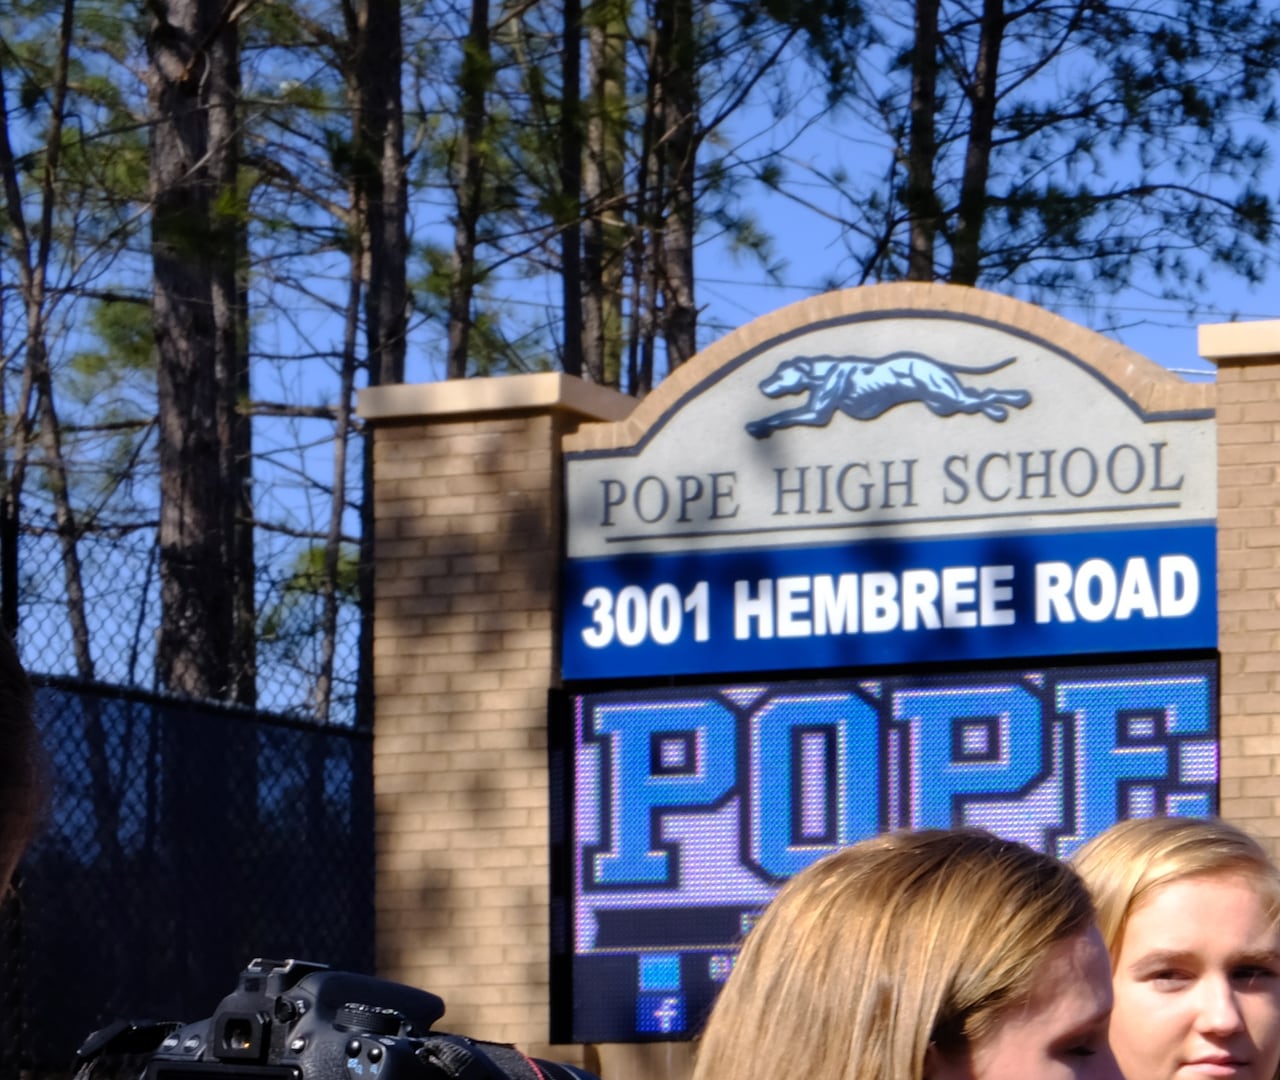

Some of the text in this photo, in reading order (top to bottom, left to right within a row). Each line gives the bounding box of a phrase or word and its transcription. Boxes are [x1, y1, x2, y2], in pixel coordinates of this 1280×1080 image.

[600, 442, 1184, 527] POPE HIGH SCHOOL
[581, 555, 1201, 649] 3001 HEMBREE ROAD
[593, 676, 1211, 884] POPE
